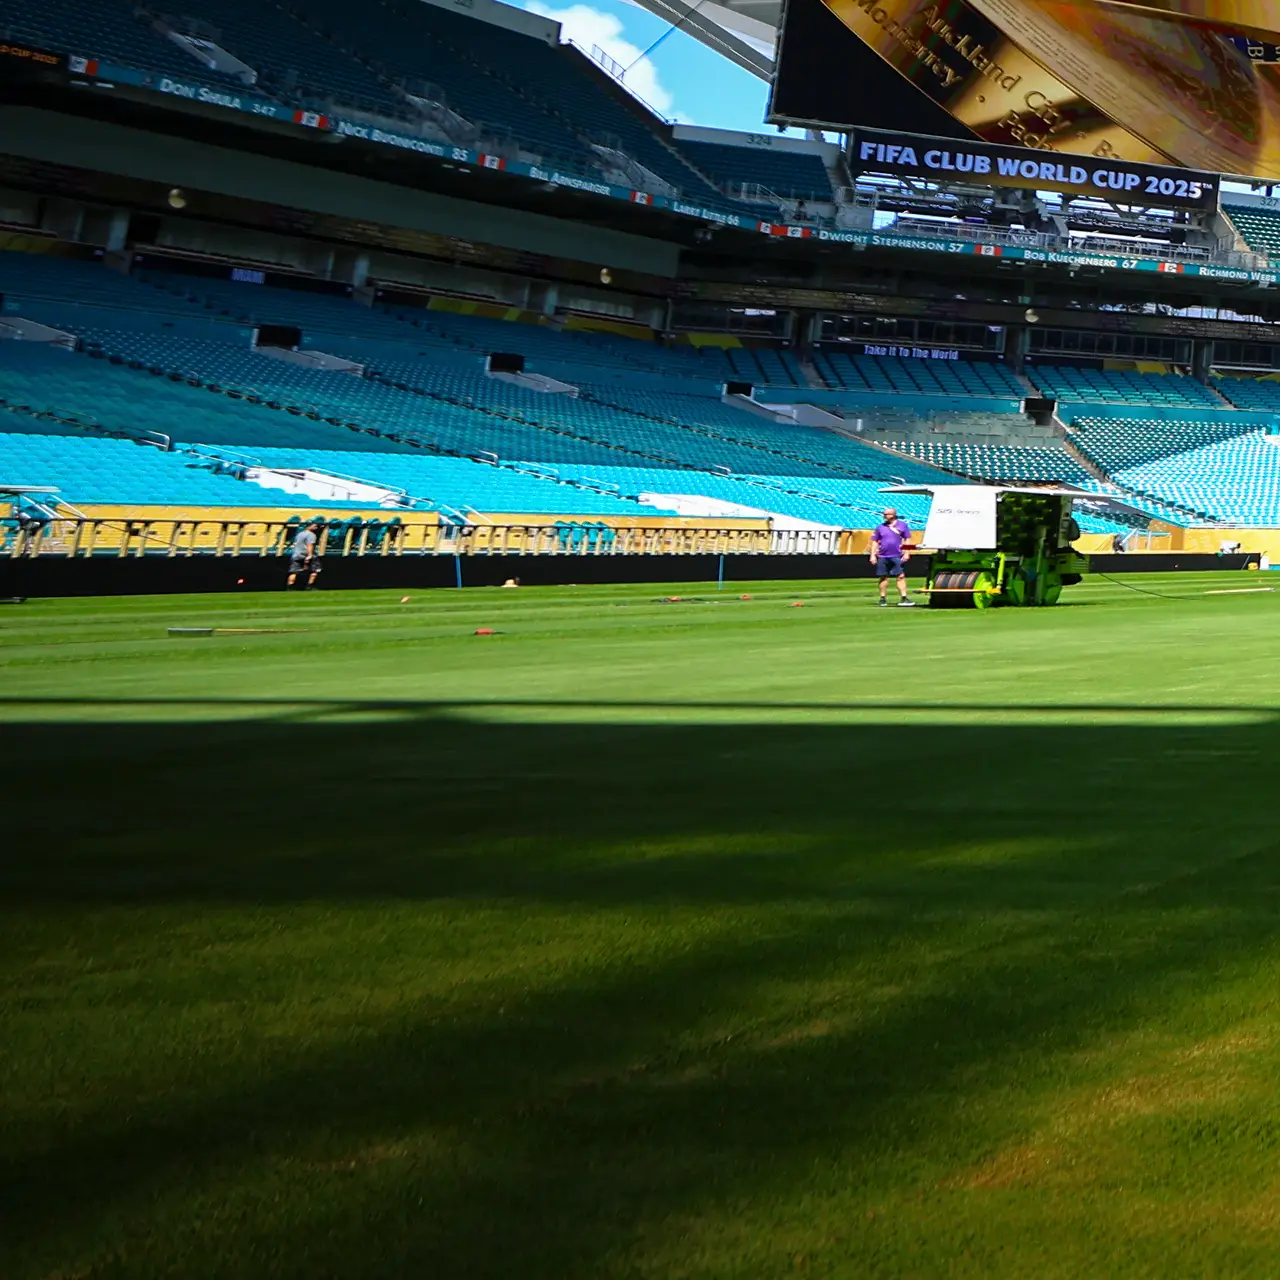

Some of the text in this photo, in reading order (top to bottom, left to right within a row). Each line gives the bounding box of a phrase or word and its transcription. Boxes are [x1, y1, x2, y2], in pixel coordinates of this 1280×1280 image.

[920, 3, 1073, 136] Auckland City
[160, 78, 277, 117] DON SHULA 347
[337, 121, 369, 139] NICK
[451, 147, 469, 162] 85
[747, 134, 772, 146] 324
[860, 140, 918, 167] FIFA
[923, 149, 992, 176] CLUB
[996, 157, 1088, 186] WORLD
[1091, 167, 1140, 193] CUP
[1260, 196, 1279, 207] 327
[727, 213, 740, 226] 66
[819, 230, 965, 253] DWIGHT STEPHENSON 57
[1023, 250, 1140, 269] BOB KUECHENBERG 67
[1198, 266, 1248, 280] RICHMOND
[1251, 270, 1277, 282] WEBB
[863, 344, 887, 357] Take
[898, 346, 910, 358] To
[911, 347, 930, 359] The
[931, 349, 959, 360] World
